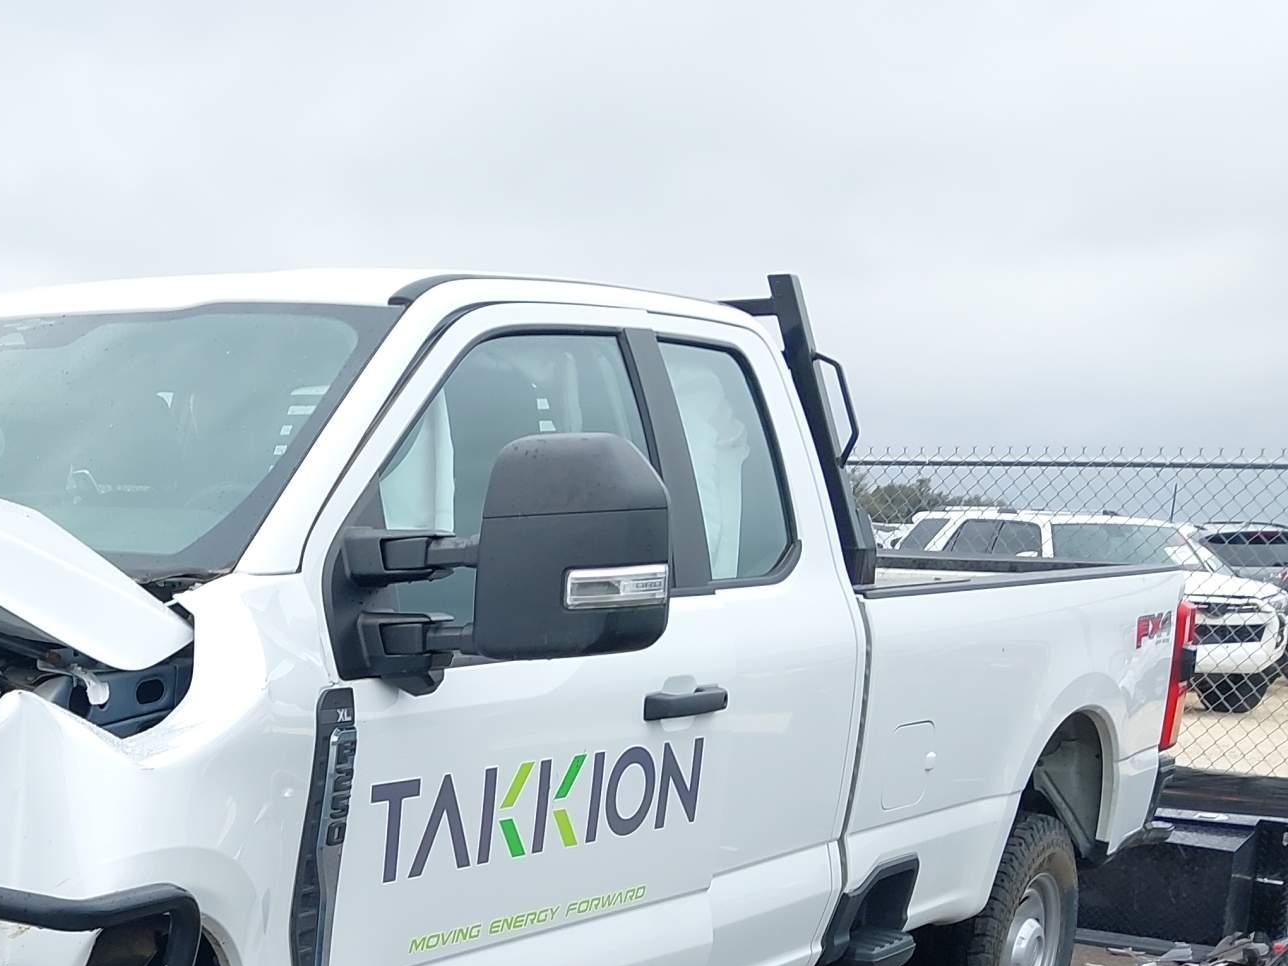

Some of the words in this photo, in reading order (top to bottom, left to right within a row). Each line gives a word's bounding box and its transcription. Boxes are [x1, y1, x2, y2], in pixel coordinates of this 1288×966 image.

[336, 708, 352, 722] XL
[370, 737, 705, 885] TAKKION
[408, 923, 483, 954] MOVING
[488, 905, 561, 936] ENERGY
[565, 885, 647, 918] FORWARD
